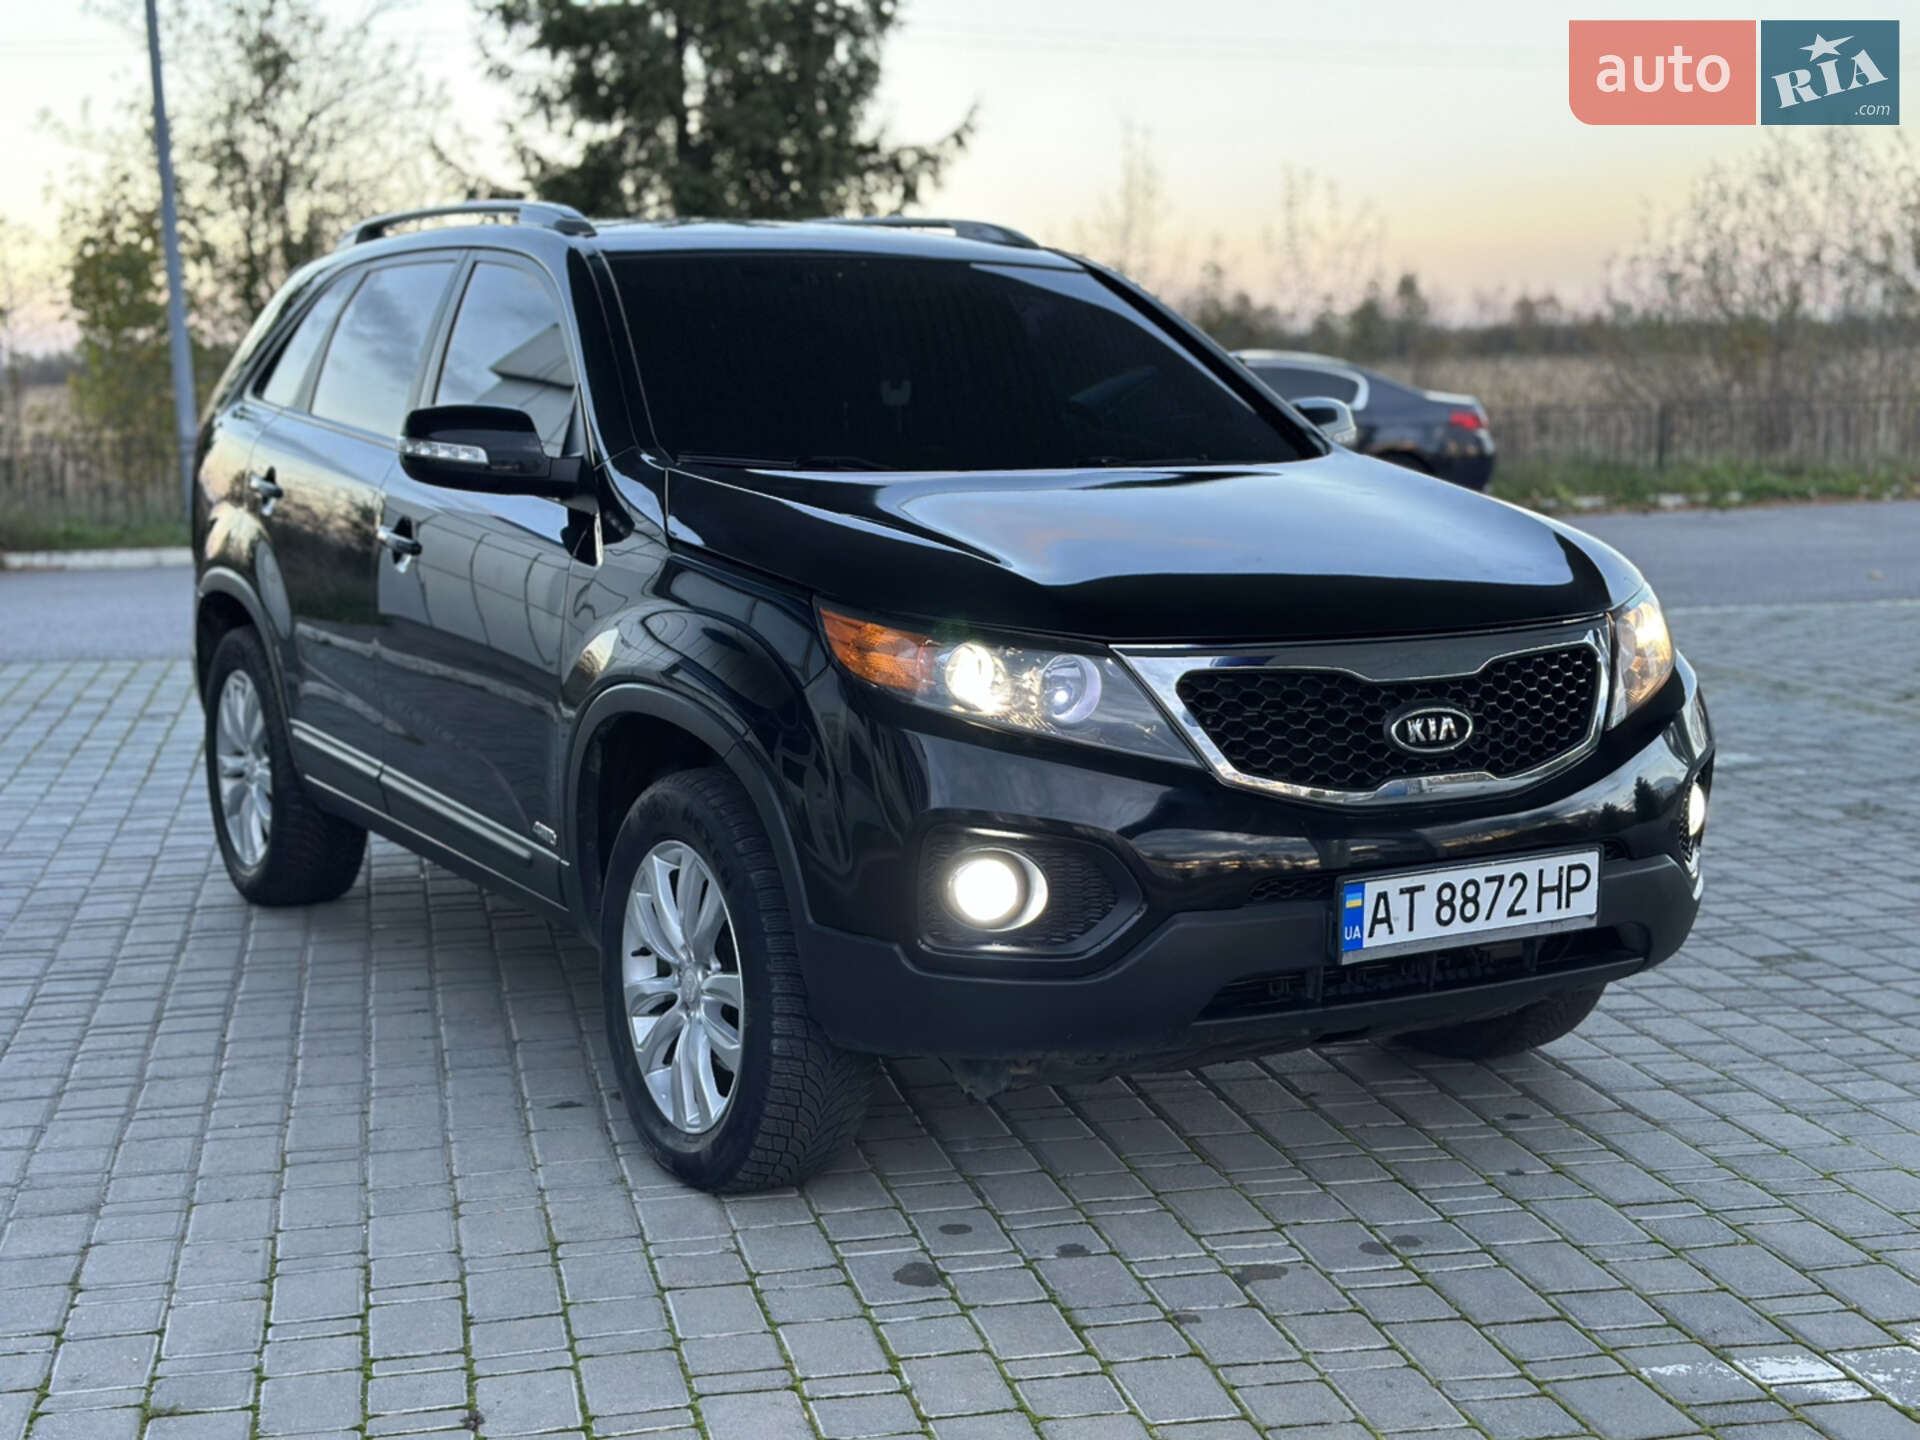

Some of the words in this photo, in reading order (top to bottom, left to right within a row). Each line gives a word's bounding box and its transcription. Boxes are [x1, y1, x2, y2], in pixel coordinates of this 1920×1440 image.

[1406, 716, 1458, 743] KIA
[1367, 884, 1426, 938] AT
[1435, 871, 1529, 927] 8872
[1536, 862, 1592, 913] HP
[1344, 925, 1362, 941] UA
